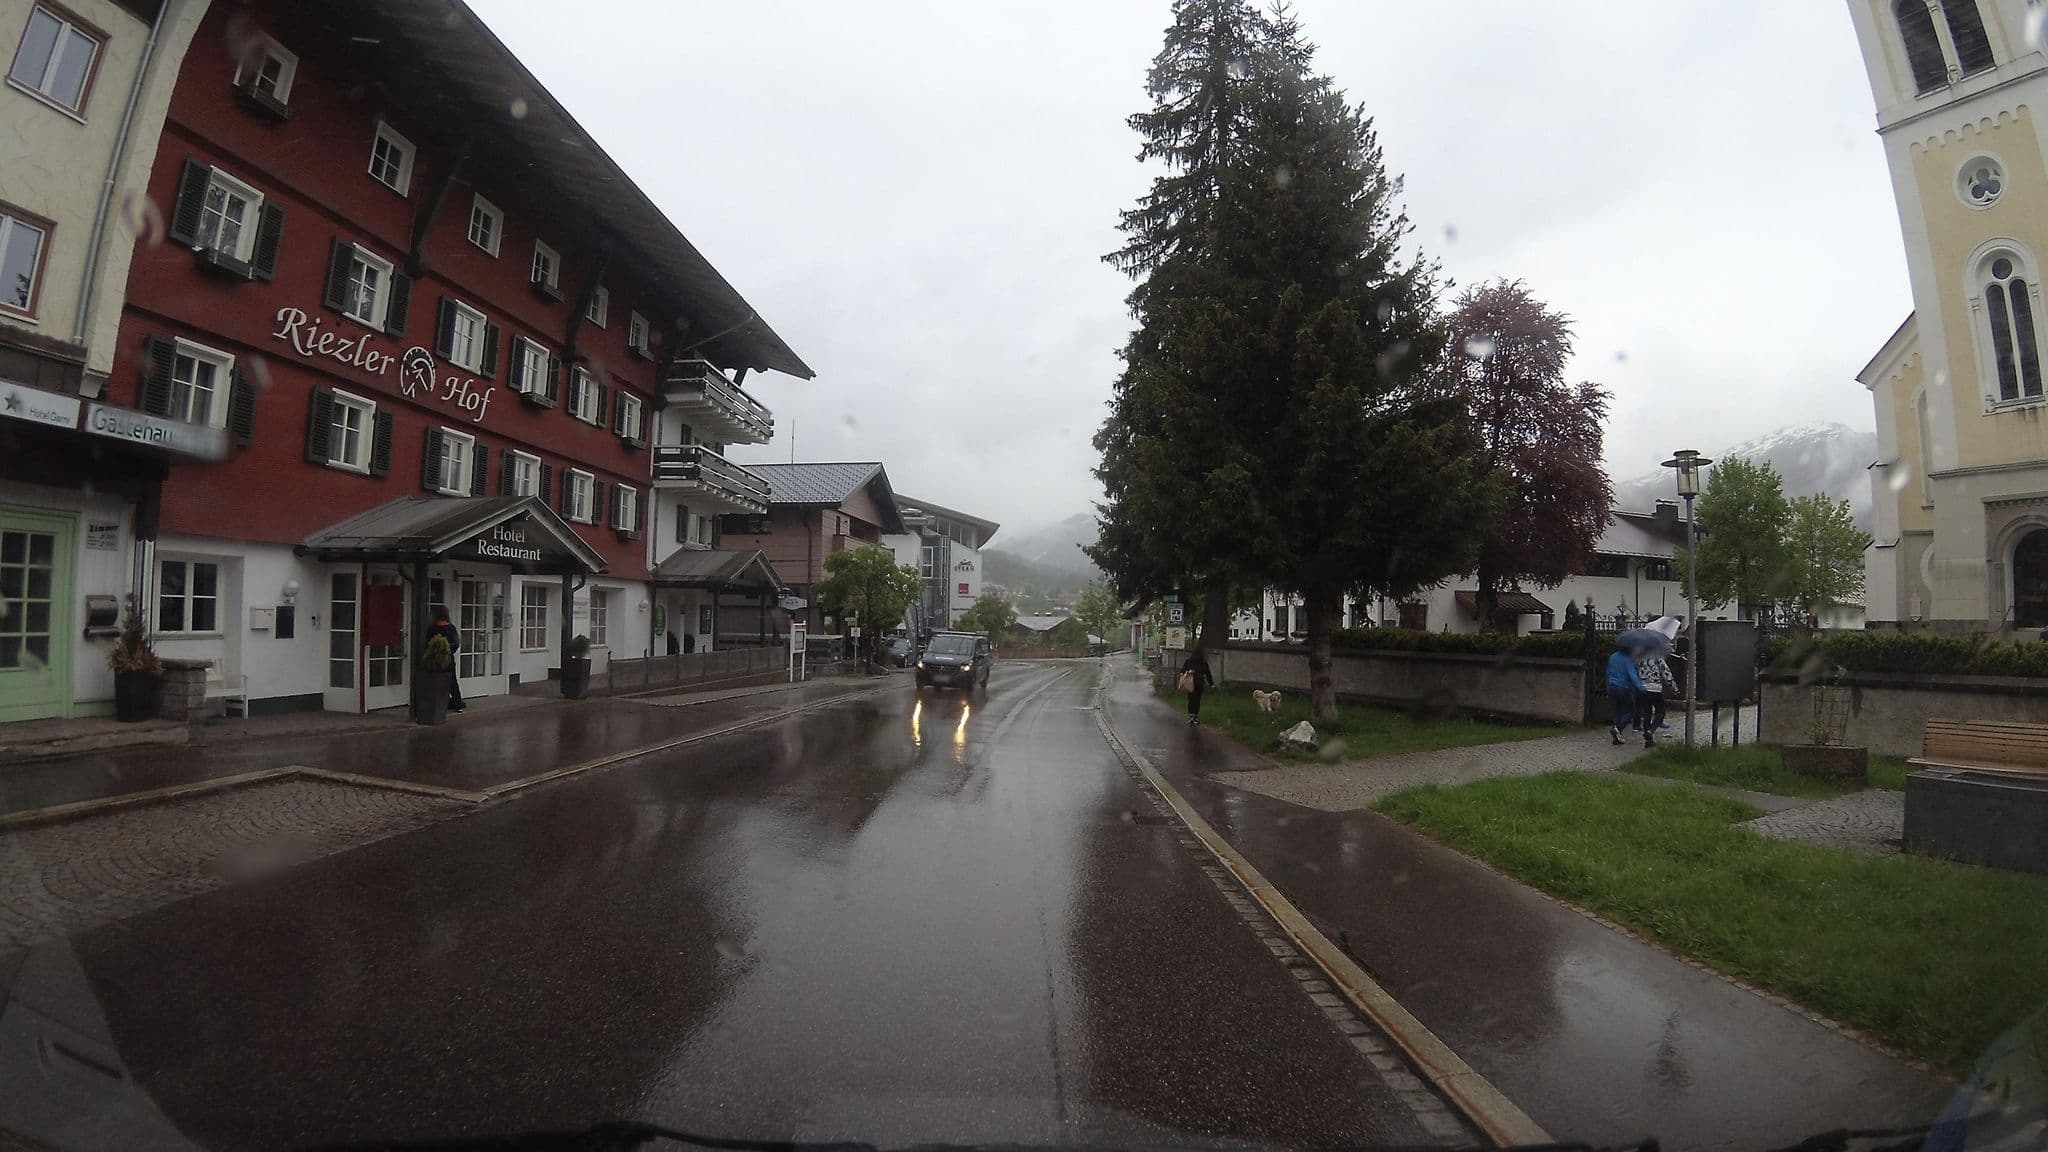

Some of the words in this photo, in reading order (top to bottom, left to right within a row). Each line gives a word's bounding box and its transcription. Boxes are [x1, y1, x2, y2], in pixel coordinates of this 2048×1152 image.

[272, 307, 395, 375] Riezler
[441, 376, 496, 423] Hof
[29, 407, 49, 420] Hotel
[50, 411, 72, 425] Garni
[93, 407, 177, 444] Gästehau
[493, 525, 525, 543] Hotel
[477, 539, 541, 561] Restaurant
